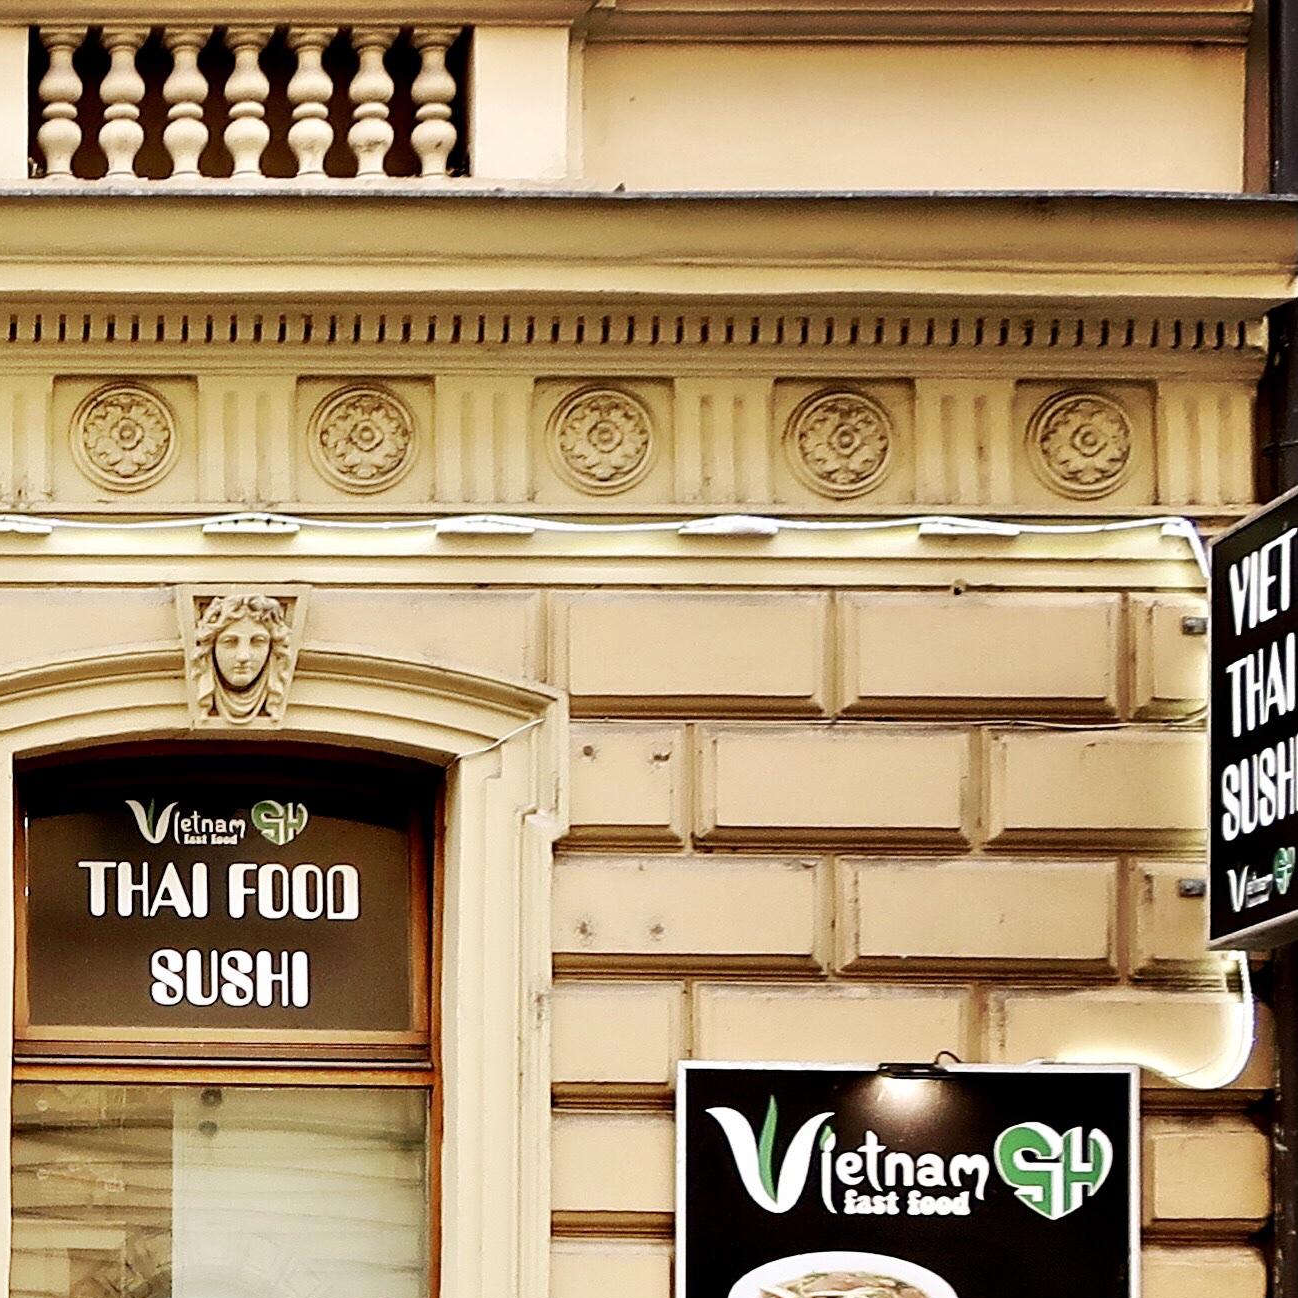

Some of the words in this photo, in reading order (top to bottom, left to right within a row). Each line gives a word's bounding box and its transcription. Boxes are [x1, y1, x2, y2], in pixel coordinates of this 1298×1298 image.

[1229, 527, 1298, 636] VIET
[1225, 632, 1297, 738] THAI
[125, 797, 245, 843] Vietnam
[184, 833, 206, 845] fast
[211, 833, 237, 845] food
[78, 862, 207, 917] THAI
[228, 863, 359, 920] FOOD
[151, 949, 308, 1007] SUSHI
[705, 1095, 989, 1214] Vietnam
[843, 1189, 900, 1215] fast
[907, 1190, 970, 1215] food
